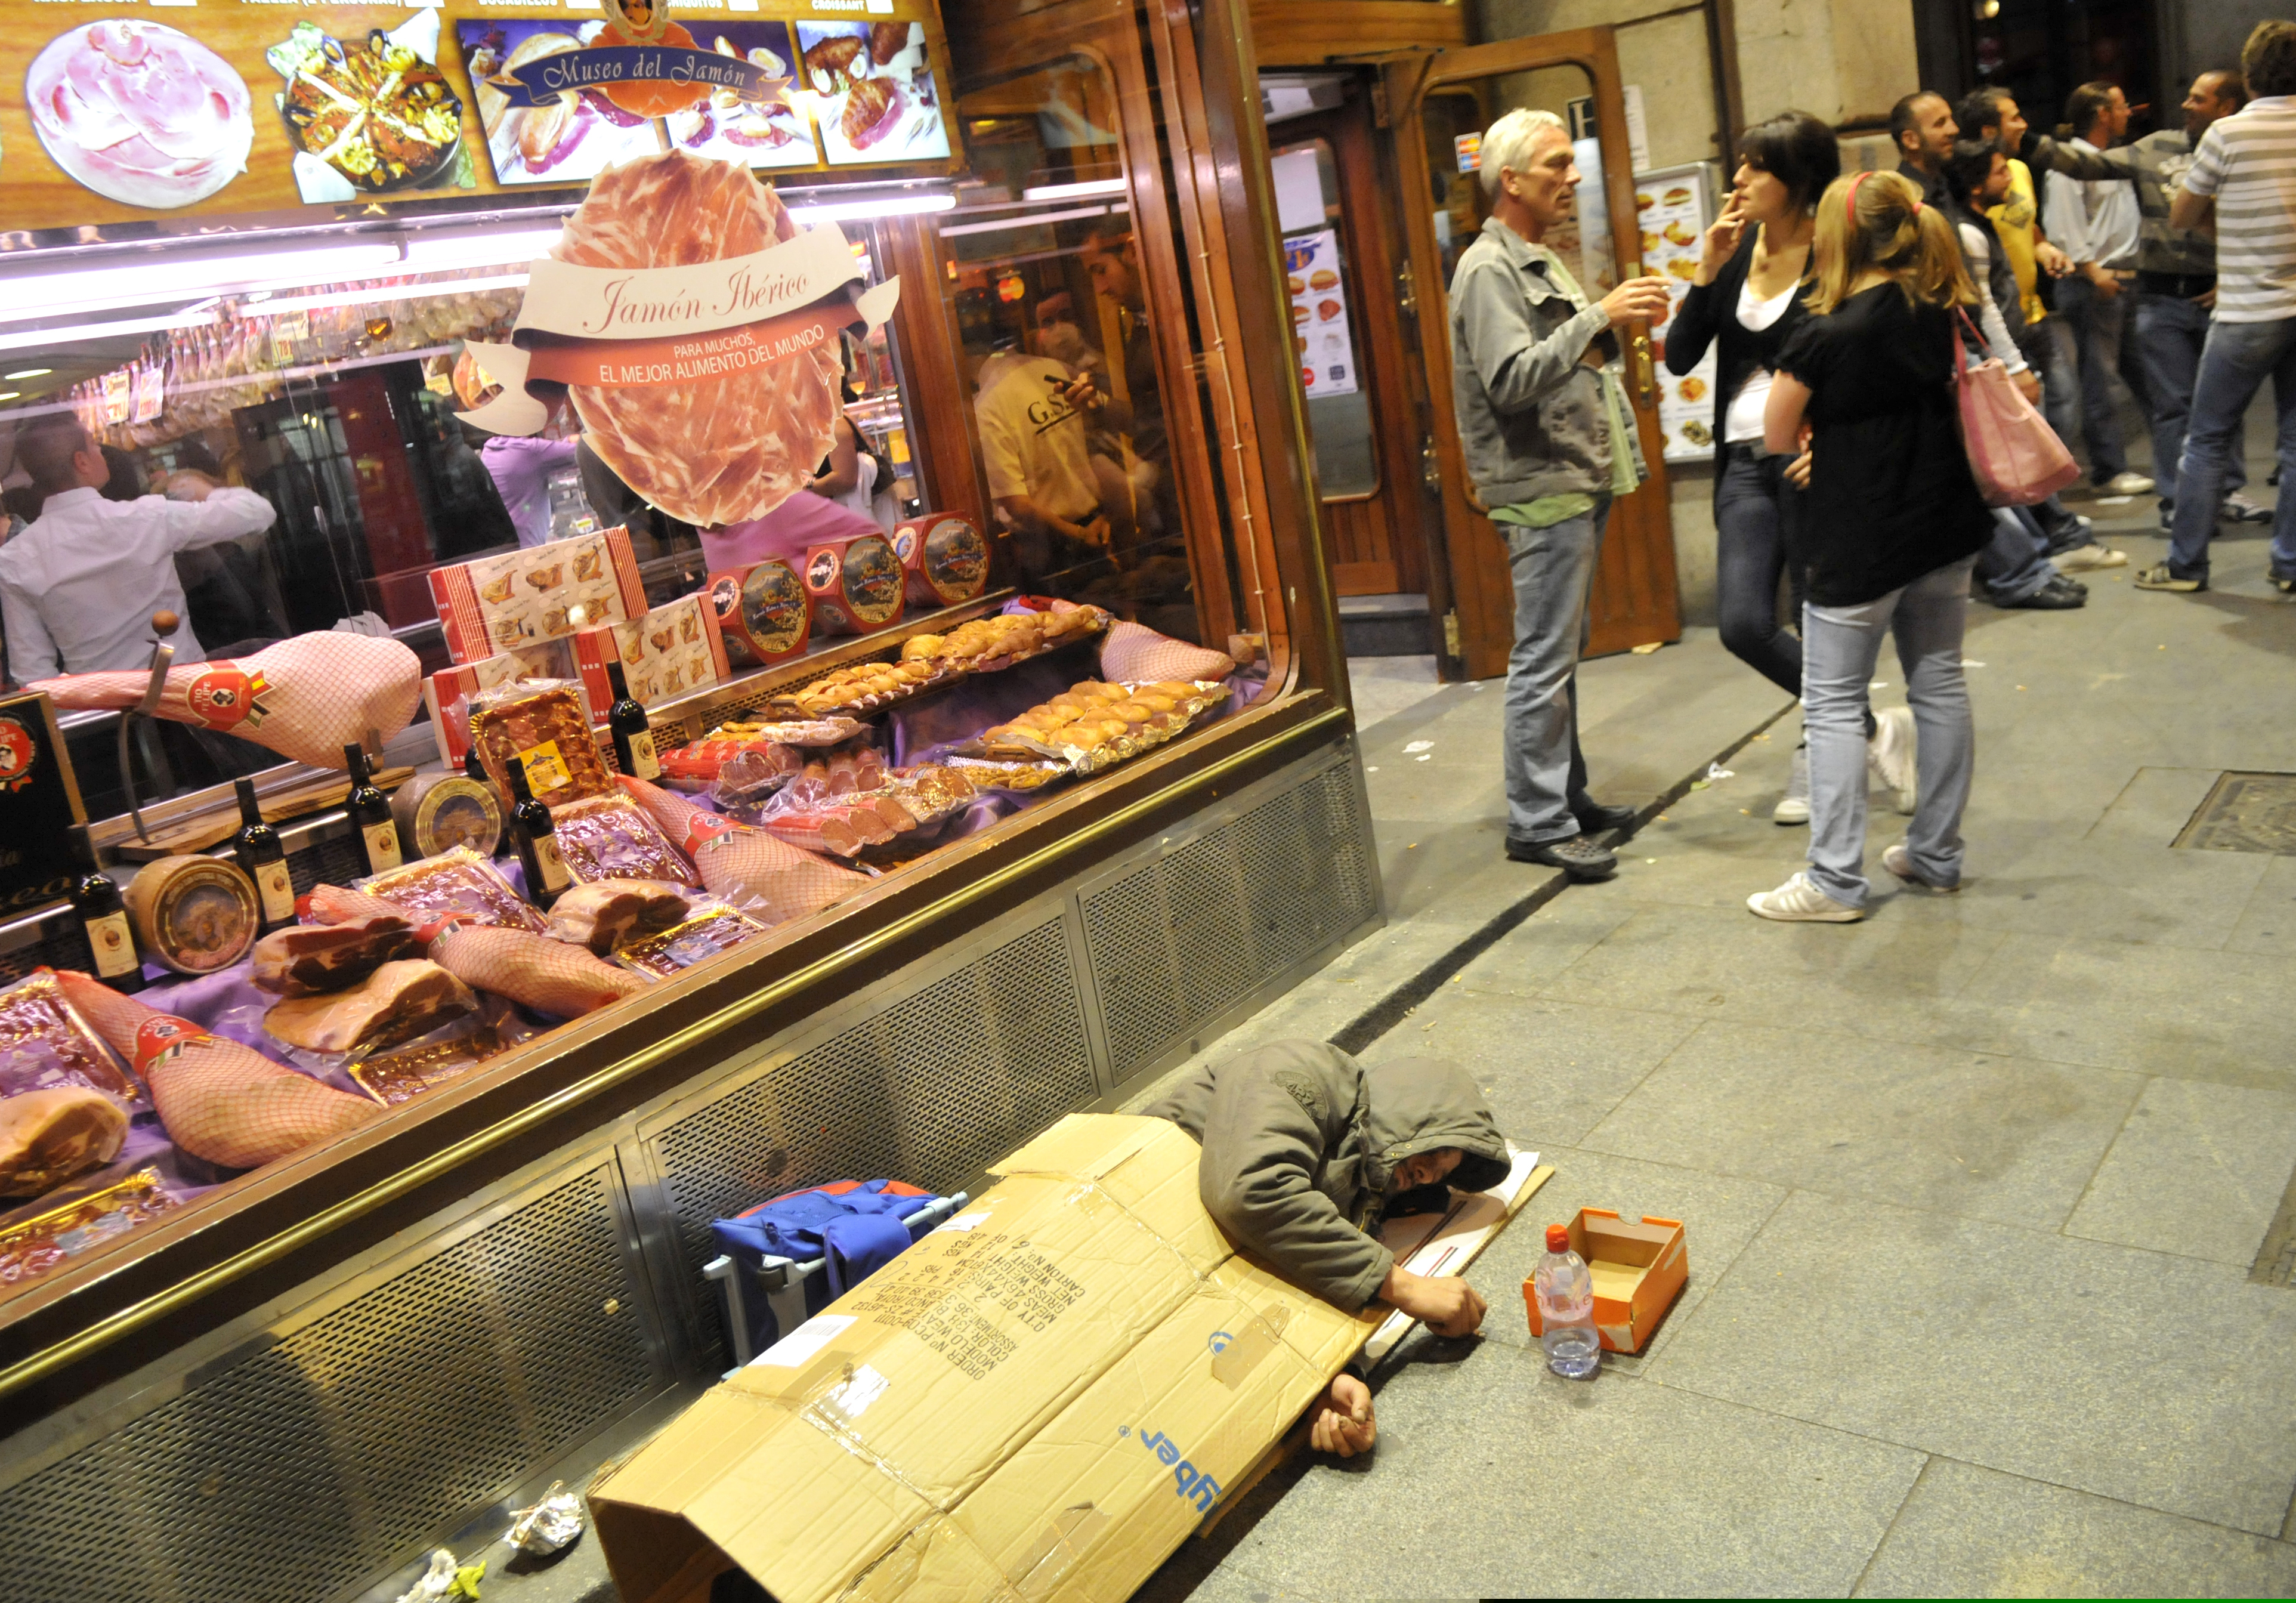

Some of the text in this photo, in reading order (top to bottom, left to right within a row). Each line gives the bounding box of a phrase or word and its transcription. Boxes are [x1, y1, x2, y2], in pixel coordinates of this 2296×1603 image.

[811, 0, 864, 11] CROISSANT
[543, 53, 745, 88] Museo del Jamón
[582, 264, 809, 333] Jamón Ibérico
[600, 324, 825, 384] EL MEJOR ALIMENTO DEL MUNDO
[673, 332, 756, 359] PARA MUCHOS,
[993, 1233, 1008, 1243] OF
[1042, 1263, 1086, 1298] CARTON
[999, 1298, 1019, 1311] OF
[1028, 1284, 1065, 1314] GROSS
[1050, 1287, 1077, 1307] NET
[947, 1349, 986, 1381] ORDER
